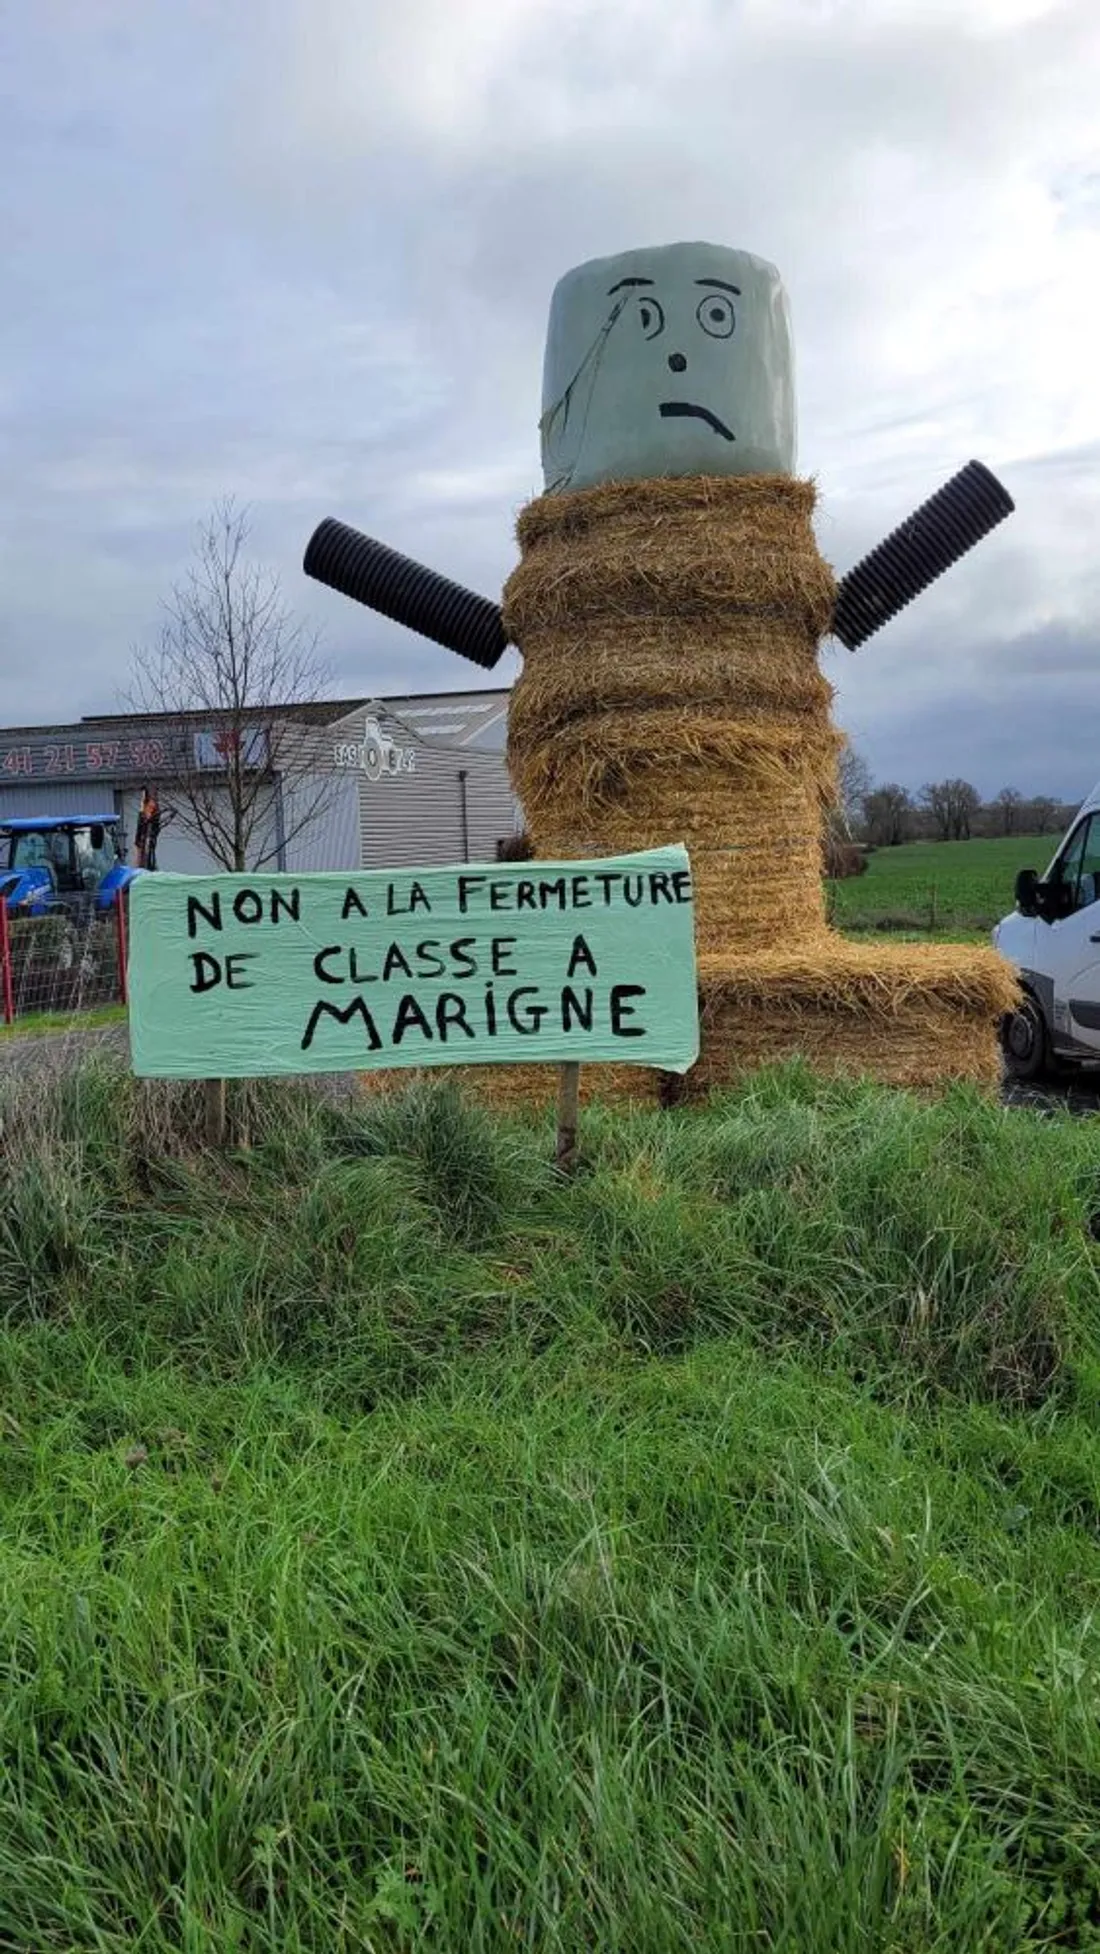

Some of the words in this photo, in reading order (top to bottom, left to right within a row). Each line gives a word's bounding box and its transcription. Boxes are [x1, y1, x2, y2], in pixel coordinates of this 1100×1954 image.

[186, 888, 300, 939] NON
[341, 887, 368, 920] A
[386, 881, 432, 914] LA
[457, 871, 693, 914] FERMETURE
[187, 951, 258, 993] DE
[313, 937, 518, 984] CLASSE
[566, 933, 598, 978] A
